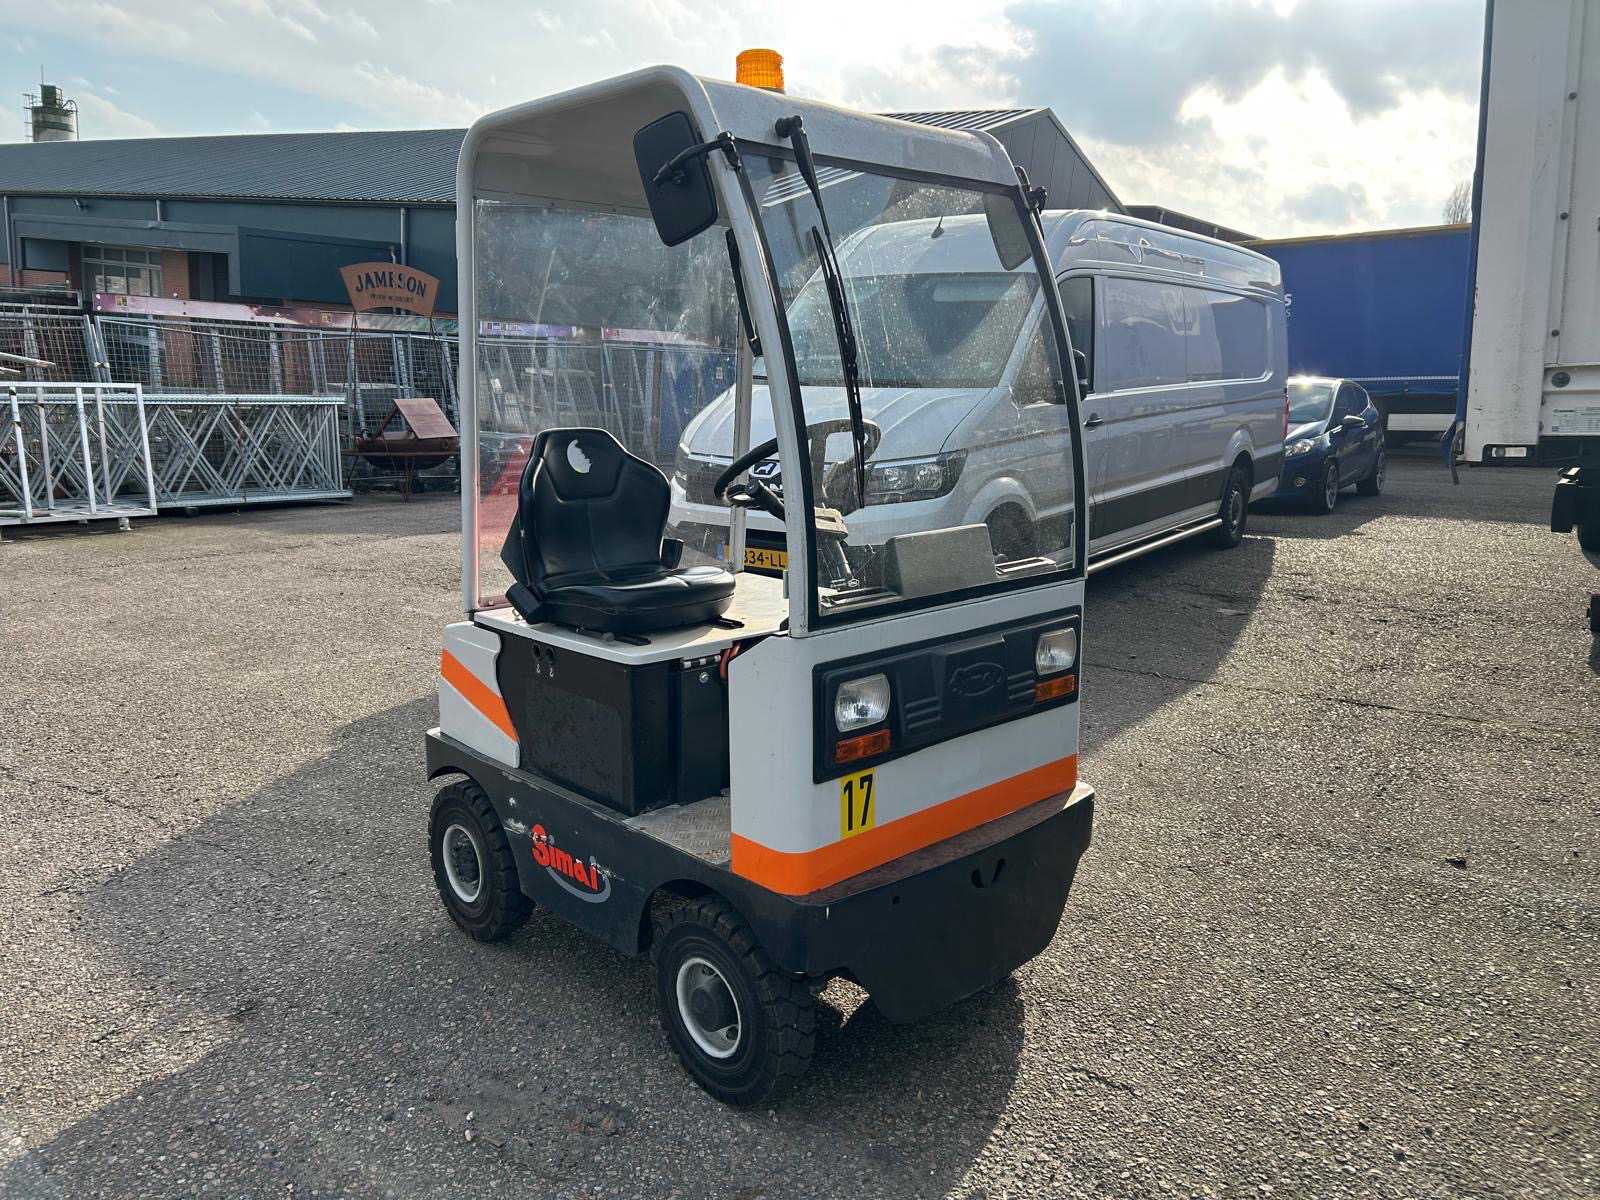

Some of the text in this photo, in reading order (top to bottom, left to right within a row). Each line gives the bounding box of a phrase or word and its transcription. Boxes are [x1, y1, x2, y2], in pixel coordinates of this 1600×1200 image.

[355, 271, 427, 297] JAMESON
[844, 774, 873, 831] 17
[531, 824, 599, 891] Simai
